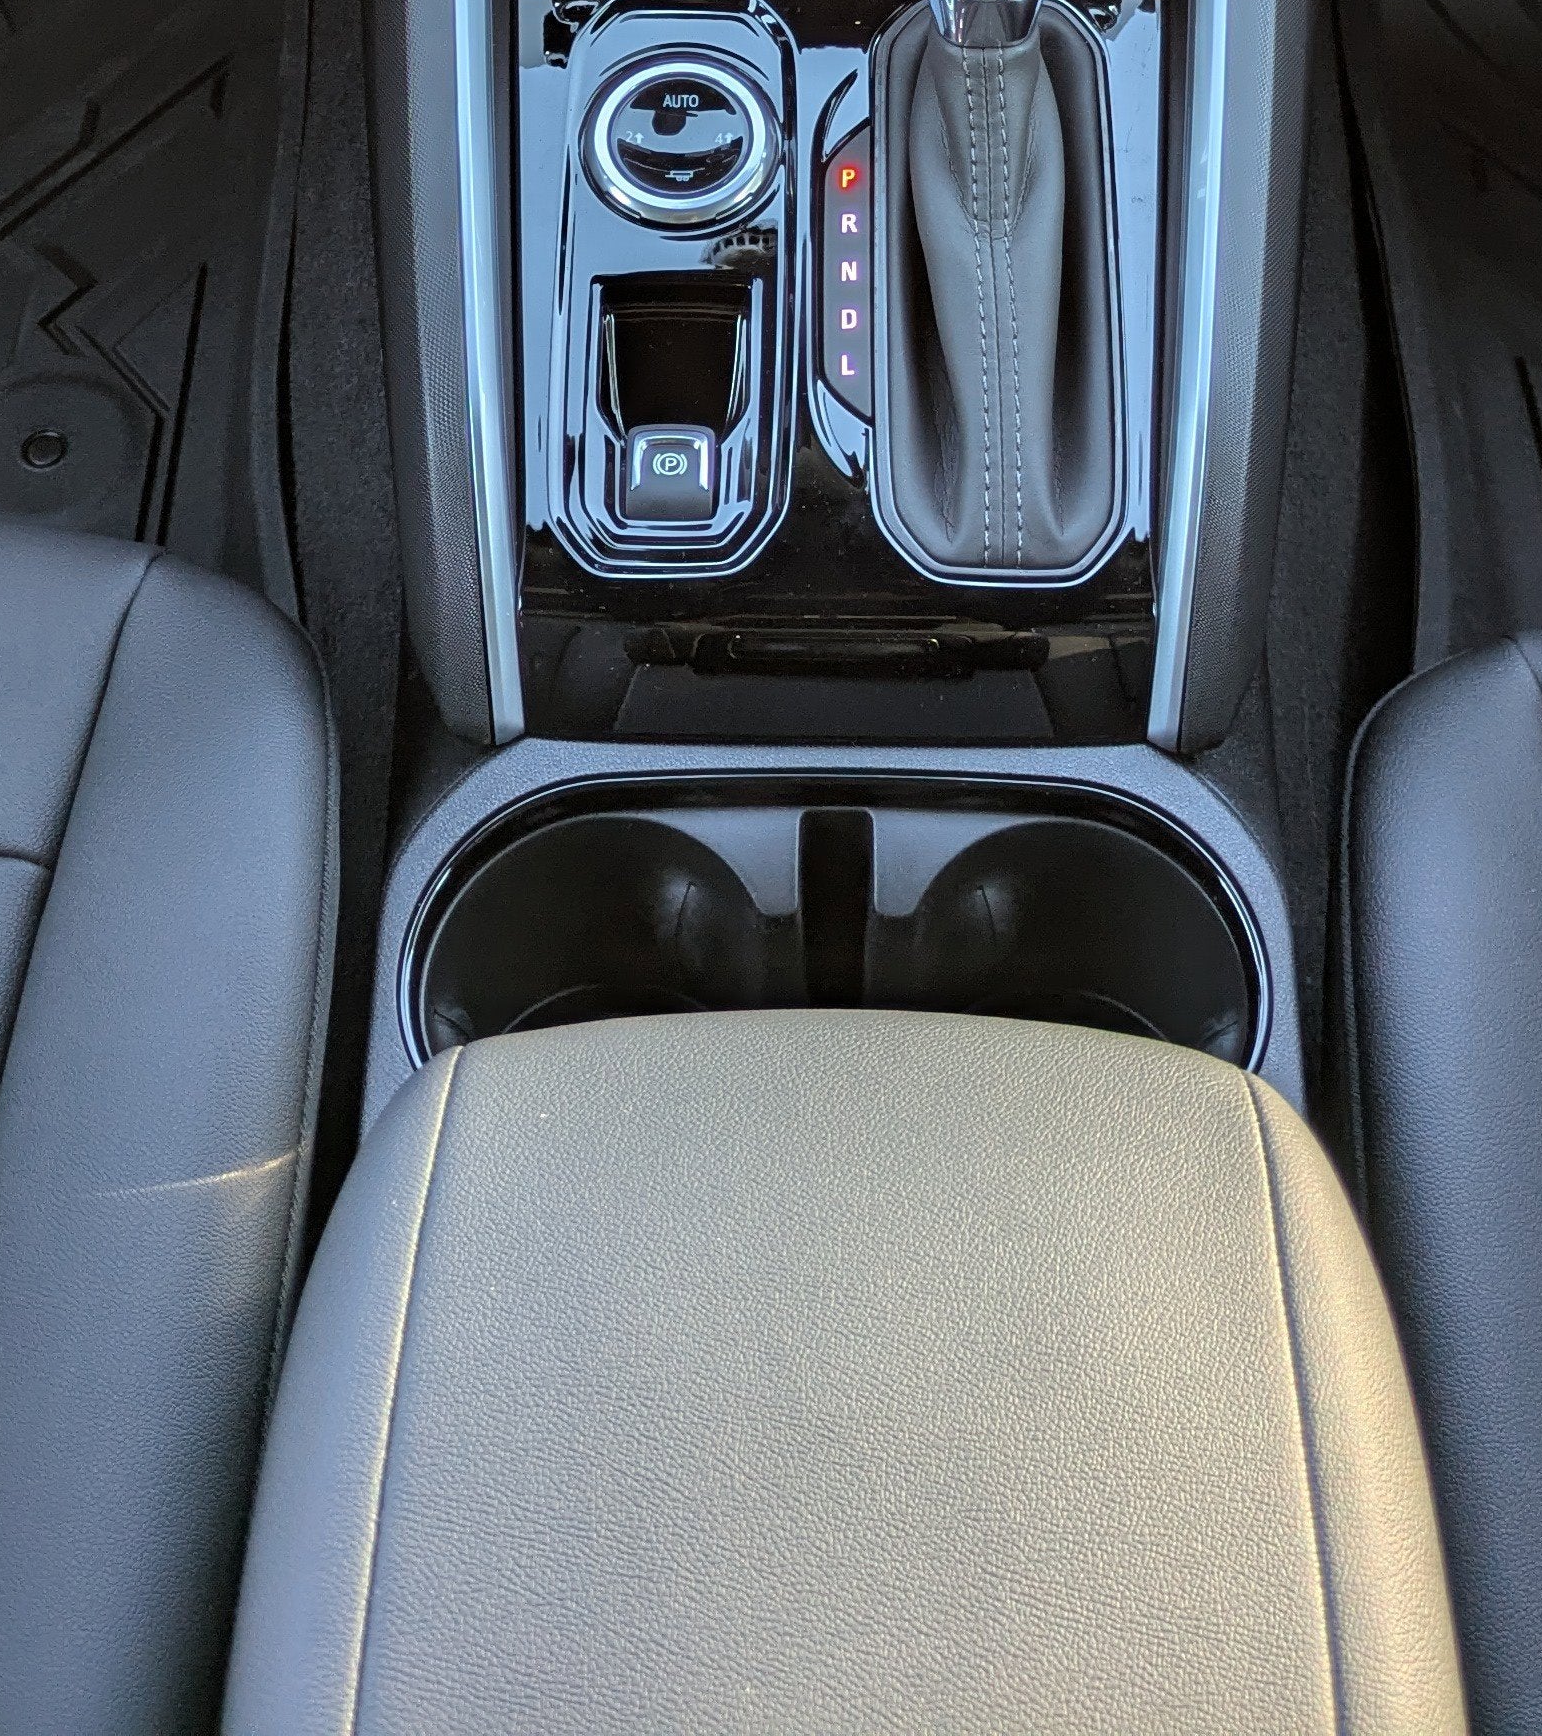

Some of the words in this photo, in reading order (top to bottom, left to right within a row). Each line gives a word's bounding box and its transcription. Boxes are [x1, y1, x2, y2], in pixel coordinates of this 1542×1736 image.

[662, 93, 700, 109] AUTO
[841, 168, 856, 188] P
[841, 213, 857, 233] R
[841, 261, 857, 281] N
[841, 309, 857, 330] D
[841, 355, 855, 376] L
